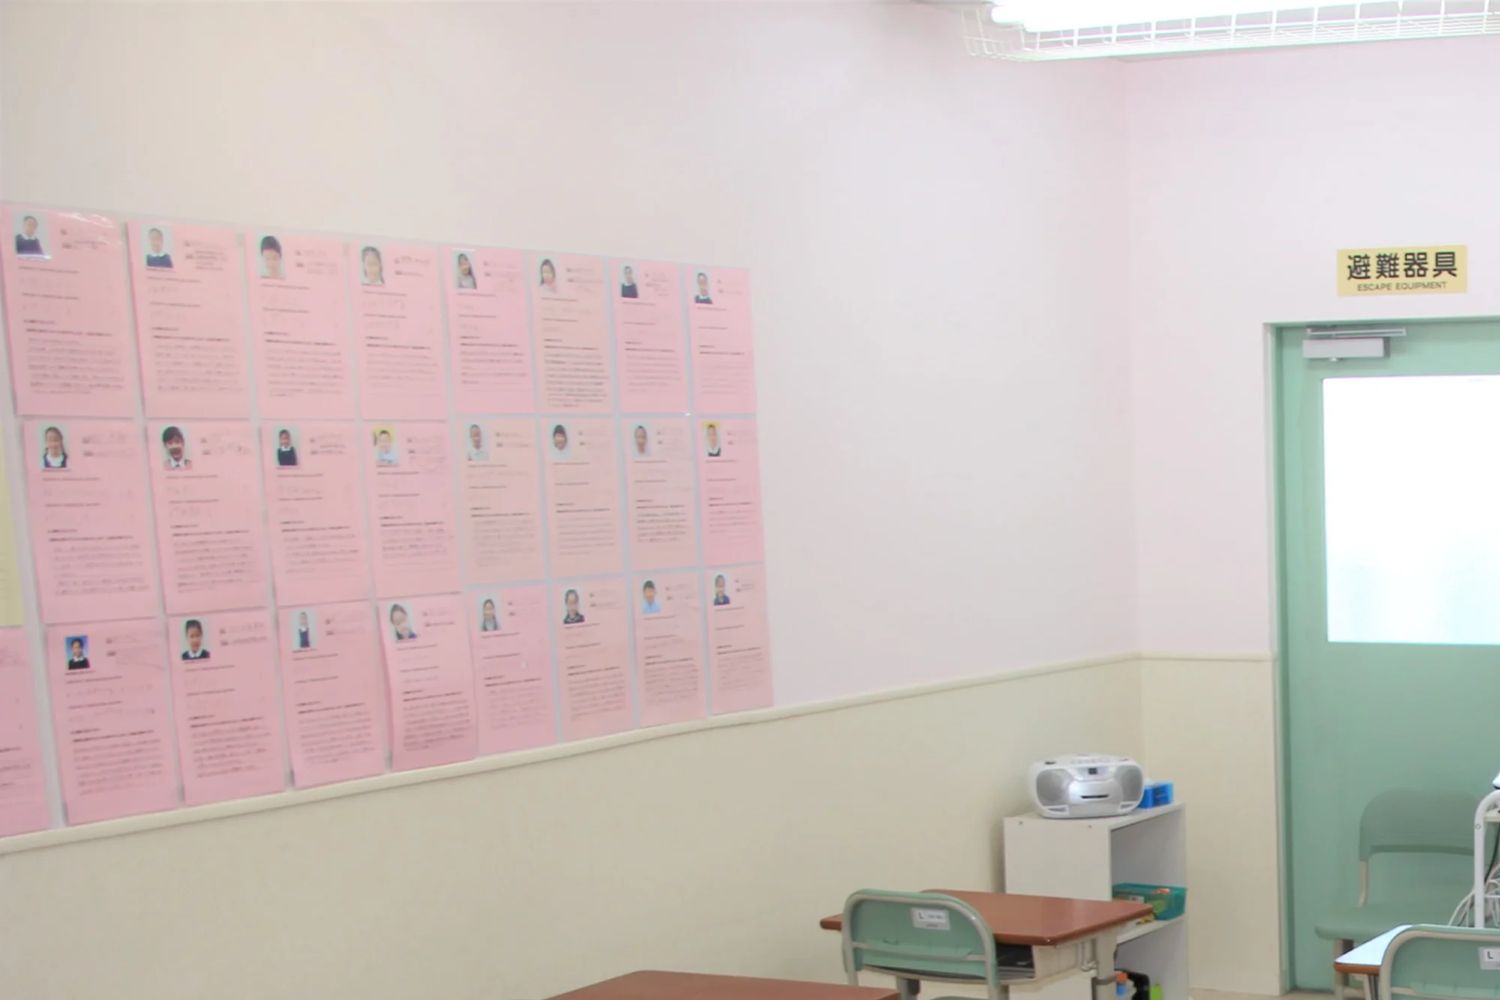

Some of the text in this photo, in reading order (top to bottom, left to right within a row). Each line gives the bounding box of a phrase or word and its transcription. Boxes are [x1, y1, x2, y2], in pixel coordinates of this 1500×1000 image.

[1347, 251, 1457, 281] 避難器具
[1357, 281, 1447, 292] ESCAPE EQUIPMENT
